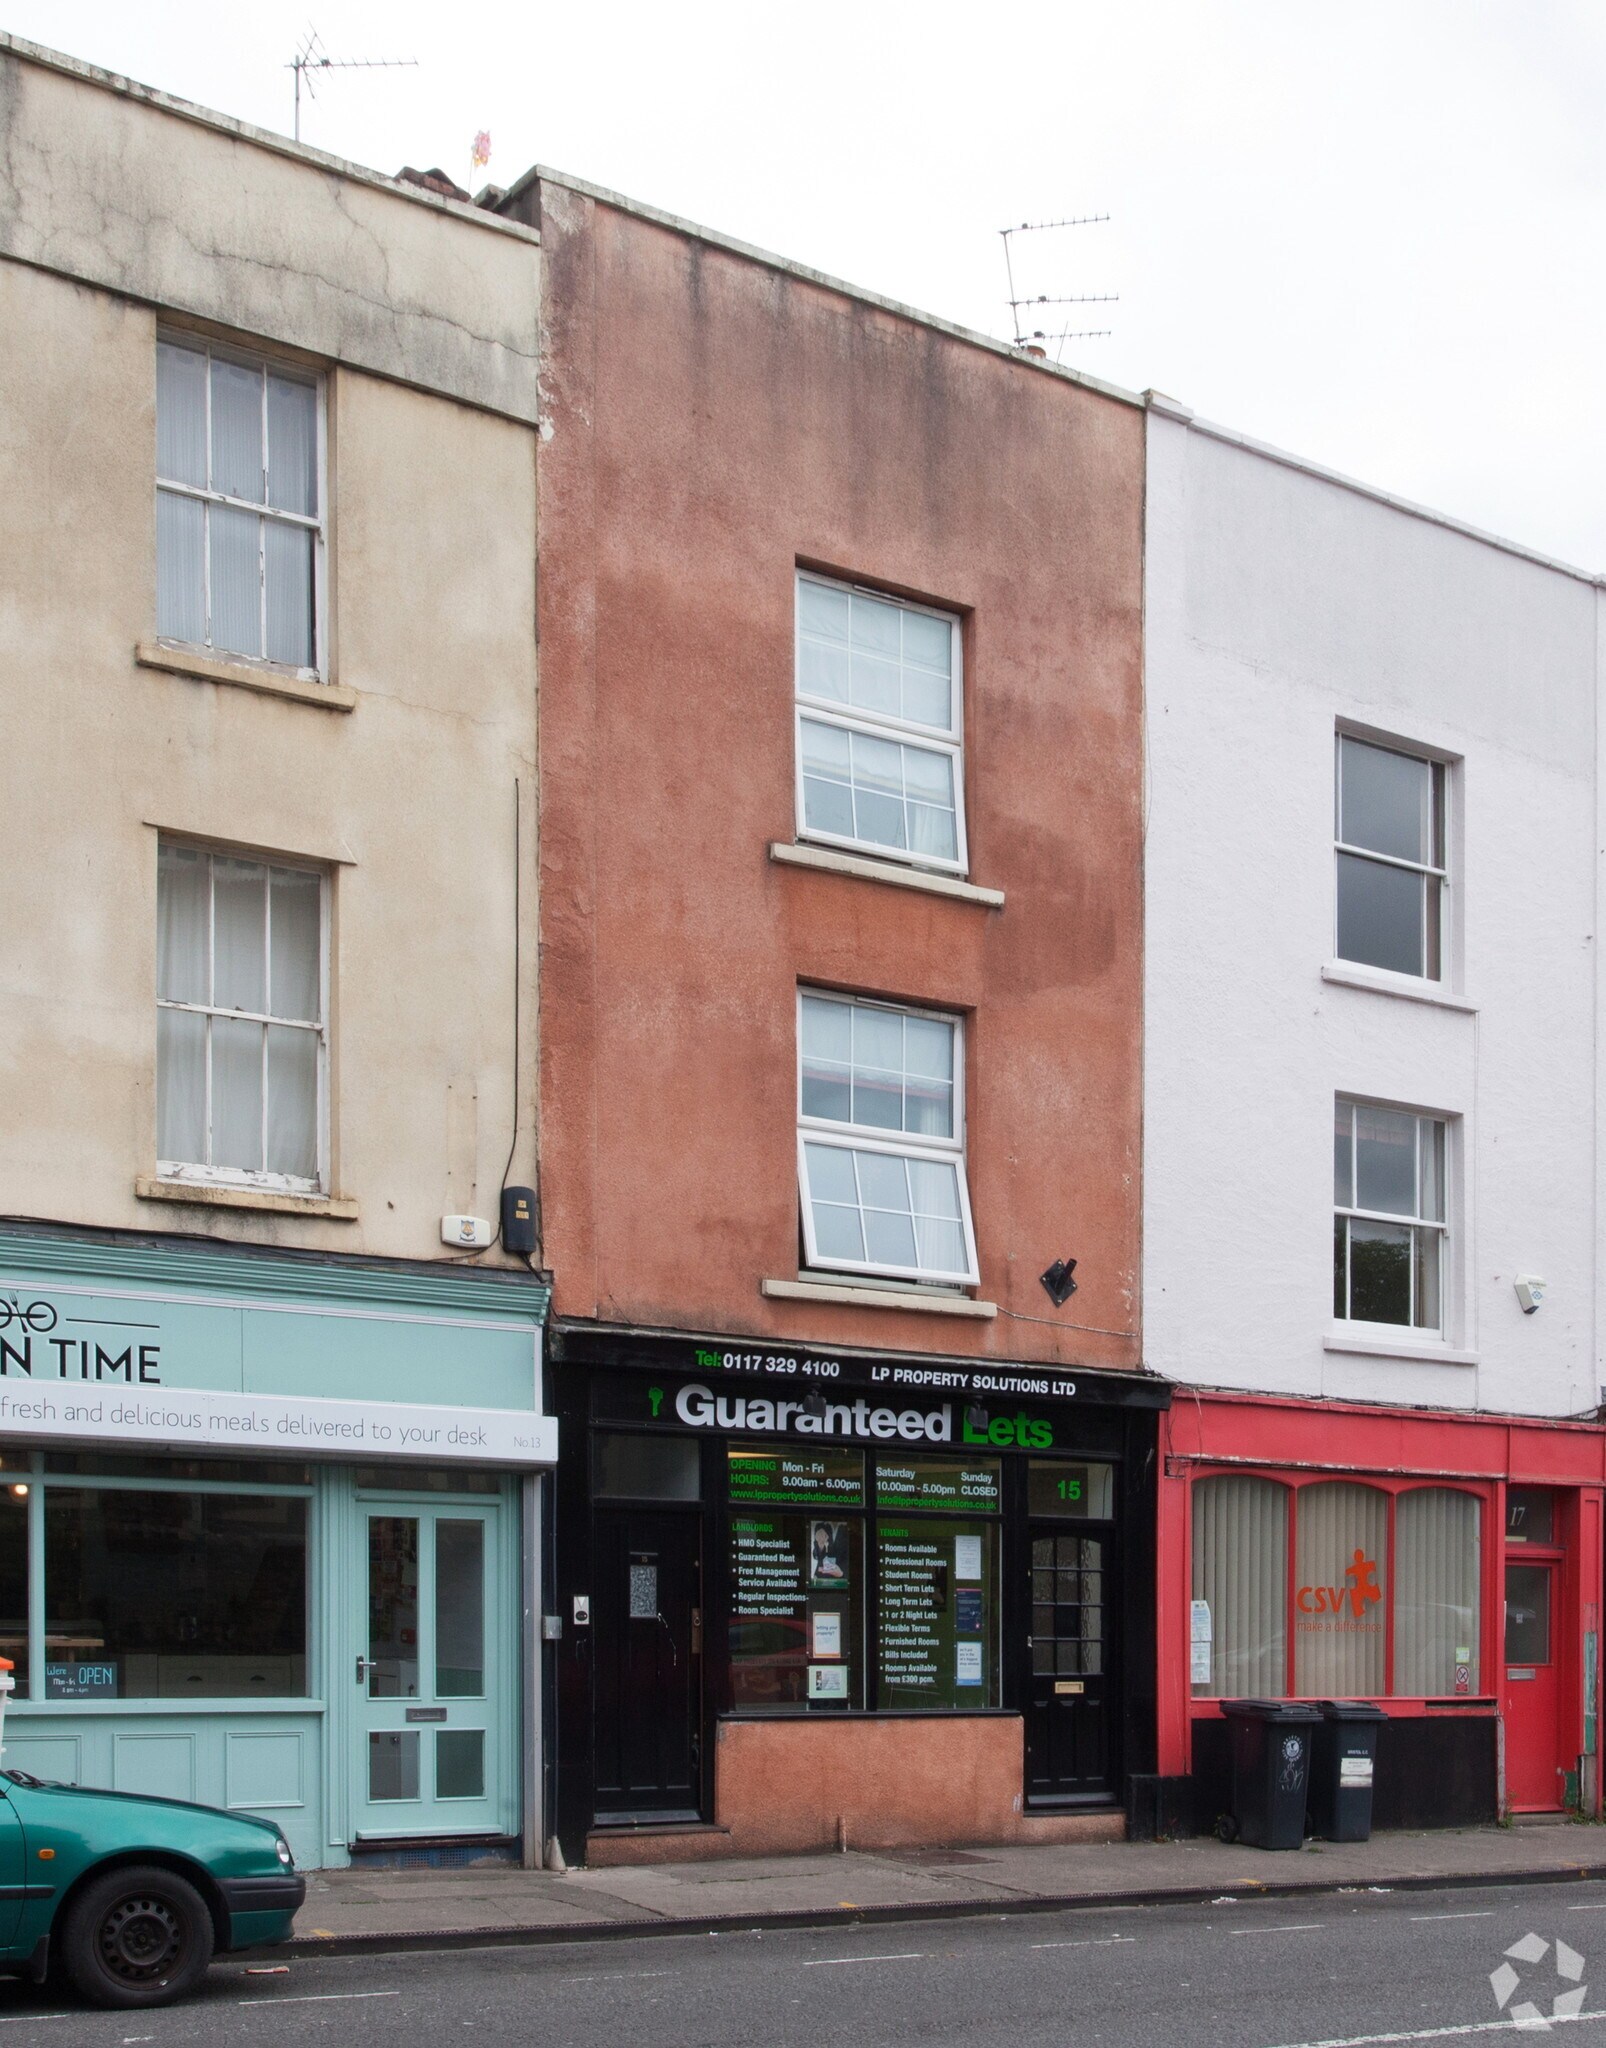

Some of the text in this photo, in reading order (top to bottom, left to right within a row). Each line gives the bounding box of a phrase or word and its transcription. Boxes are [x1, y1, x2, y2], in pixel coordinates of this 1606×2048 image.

[49, 1338, 161, 1384] TIME
[695, 1350, 840, 1377] Tel: 0117 329 4100
[871, 1366, 1076, 1396] LP PROPERTY SOLUTIONS LTD
[0, 1396, 56, 1420] fresh
[64, 1401, 102, 1422] and
[110, 1402, 202, 1428] delicious
[209, 1411, 269, 1433] meals
[276, 1413, 364, 1438] delivered
[372, 1421, 392, 1440] to
[399, 1427, 441, 1445] your
[447, 1424, 487, 1446] desk
[675, 1383, 1053, 1449] Guaranteed Lets
[730, 1459, 777, 1471] OPENING
[782, 1461, 804, 1473] Mon
[811, 1463, 825, 1474] Fri
[876, 1466, 916, 1480] Saturday
[960, 1471, 993, 1485] Sunday
[730, 1473, 770, 1485] HOURS:
[782, 1476, 818, 1488] 9.00am
[825, 1478, 861, 1491] 6.00pm
[877, 1481, 915, 1493] 10.00am
[922, 1483, 956, 1496] 5.00pm
[960, 1485, 998, 1497] CLOSED
[1057, 1480, 1081, 1500] 15
[730, 1489, 861, 1503] www.lppropertysolutions.co.uk
[1510, 1506, 1526, 1526] 17
[732, 1523, 773, 1533] LANDLORDS
[738, 1539, 790, 1549] HMO Specialist
[885, 1543, 938, 1554] Rooms Available
[738, 1552, 795, 1562] Guaranteed Rent
[885, 1557, 947, 1567] Professional Rooms
[738, 1566, 800, 1577] Free Management
[885, 1570, 933, 1580] Student Rooms
[738, 1578, 798, 1588] Service Available
[885, 1584, 935, 1593] Short Term Lets
[738, 1591, 765, 1602] Regular
[885, 1597, 933, 1607] Long Term Lets
[1297, 1586, 1346, 1614] CSV
[738, 1606, 794, 1616] Room Specialist
[905, 1611, 923, 1620] Night
[924, 1611, 938, 1619] Lets
[885, 1623, 931, 1632] Flexible Terms
[1297, 1620, 1382, 1632] make a difference
[885, 1637, 940, 1646] Furnished Rooms
[885, 1650, 928, 1659] Bills Included
[885, 1664, 938, 1673] Rooms Available
[79, 1666, 113, 1685] OPEN
[885, 1675, 901, 1683] from
